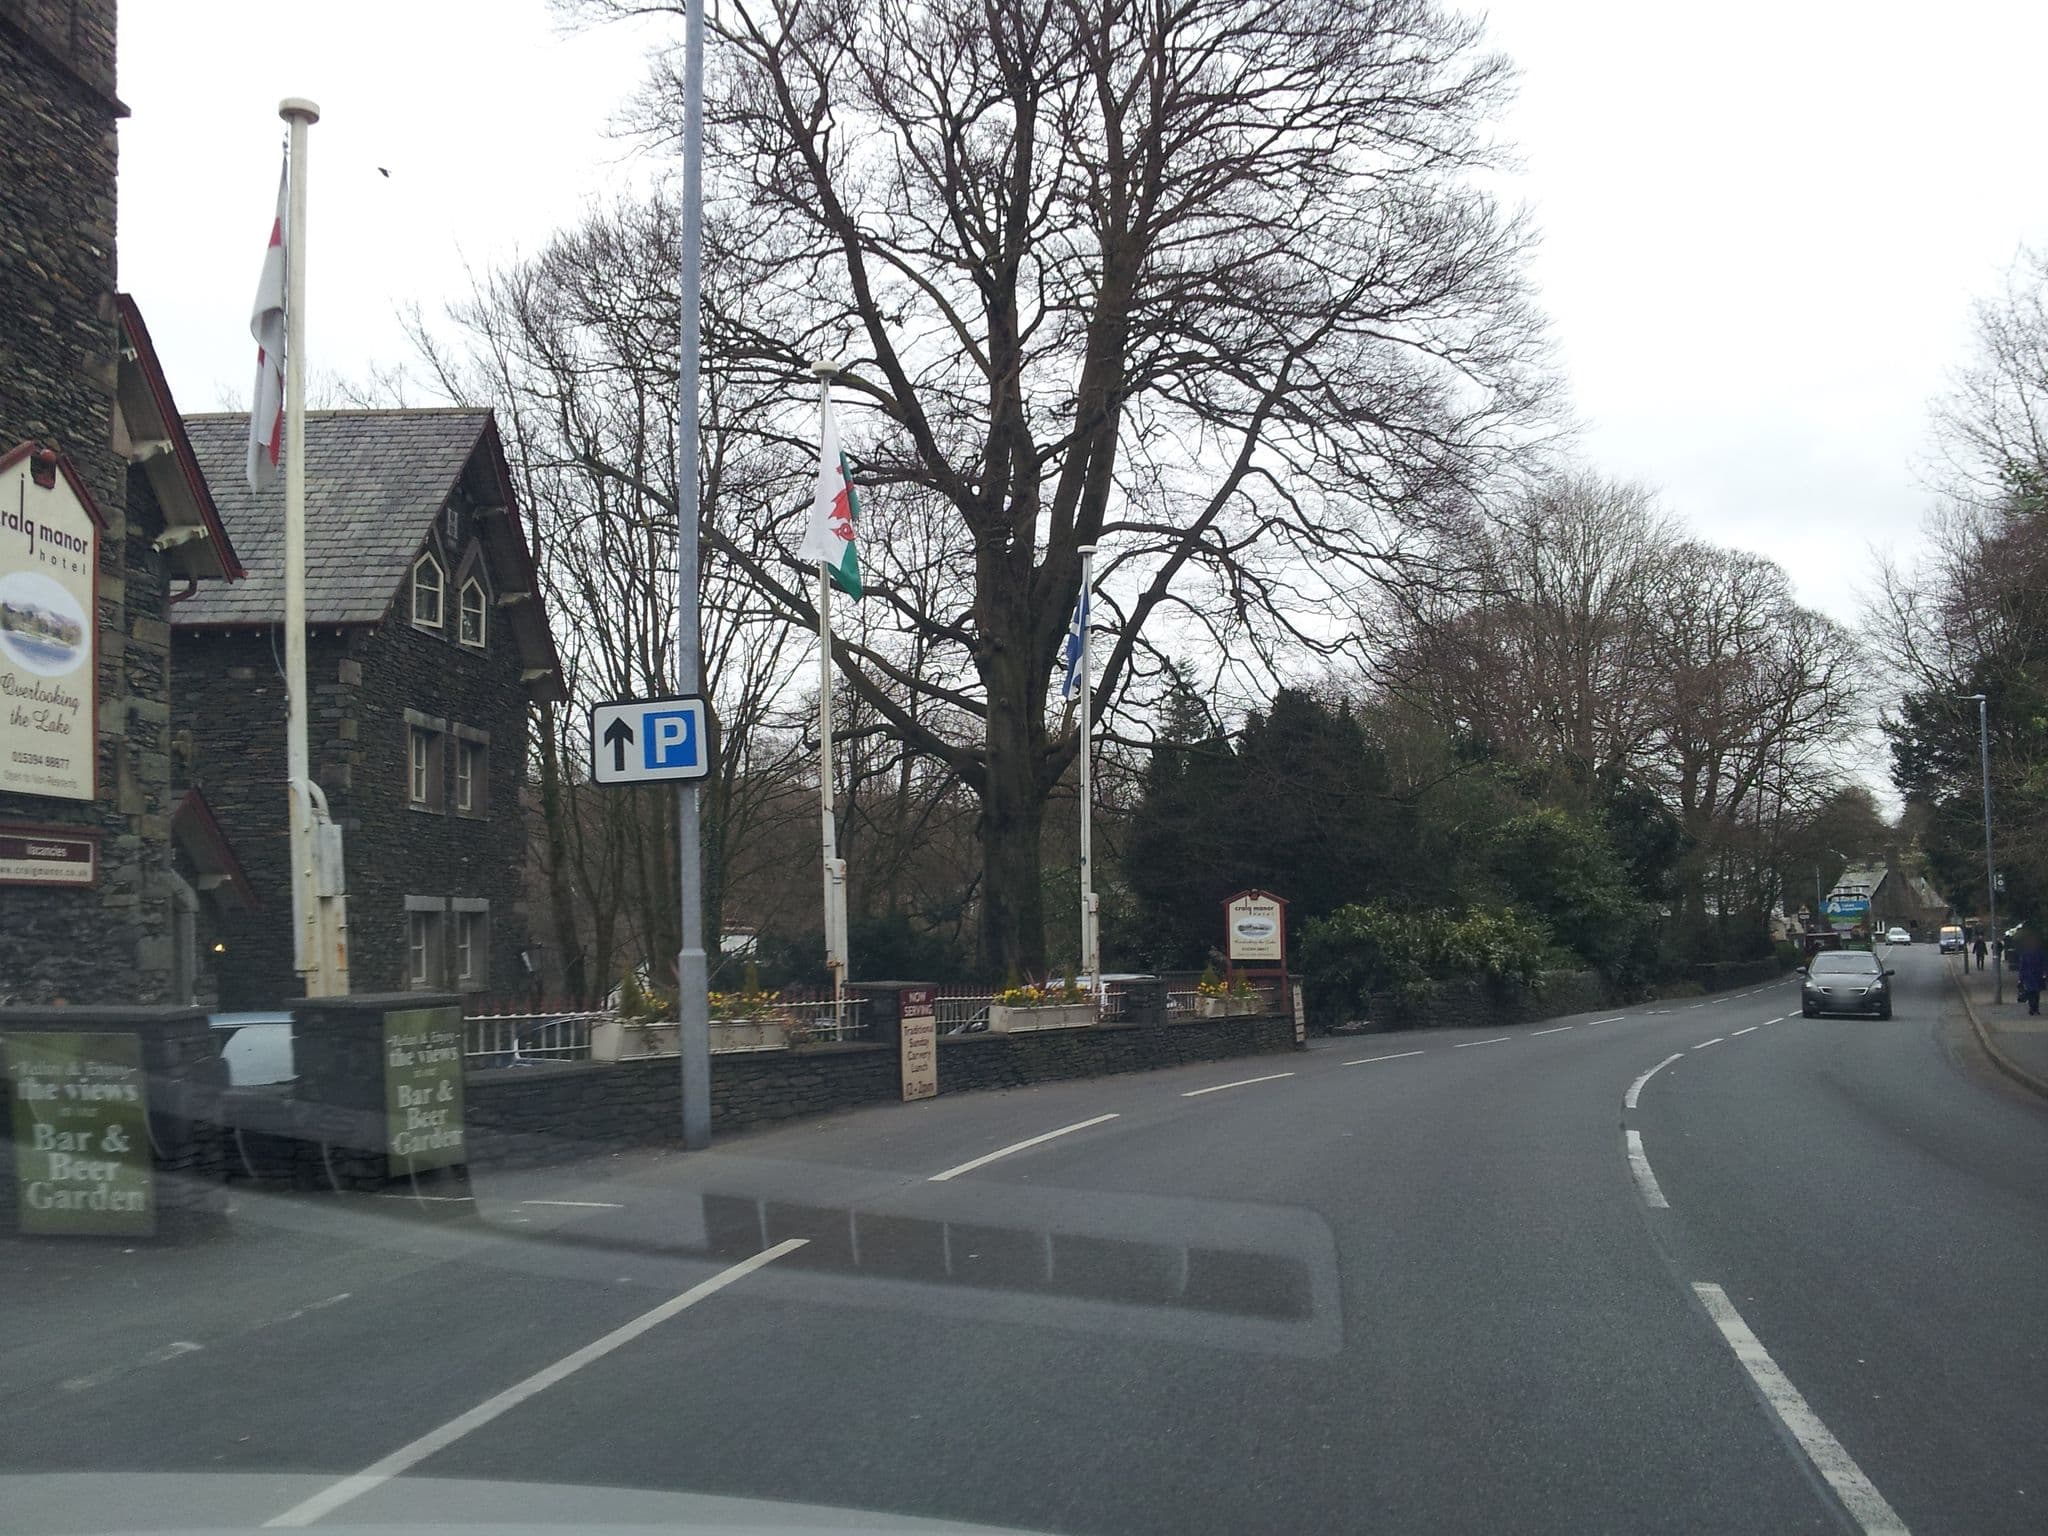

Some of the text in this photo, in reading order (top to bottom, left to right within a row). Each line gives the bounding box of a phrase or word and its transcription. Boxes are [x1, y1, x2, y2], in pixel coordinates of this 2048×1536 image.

[40, 524, 88, 555] manor
[40, 548, 86, 575] hotel
[0, 672, 80, 716] Overlooking
[10, 705, 70, 735] the Lake
[655, 717, 687, 763] P
[904, 1004, 933, 1017] SERVING
[908, 991, 927, 1003] NOW
[418, 1044, 459, 1064] views
[17, 1077, 140, 1101] the views
[398, 1079, 454, 1108] Bar &
[407, 1107, 448, 1130] Beer
[32, 1123, 131, 1152] Bar &
[392, 1128, 463, 1156] Garden
[48, 1152, 121, 1181] Beer
[27, 1181, 145, 1212] Garden
